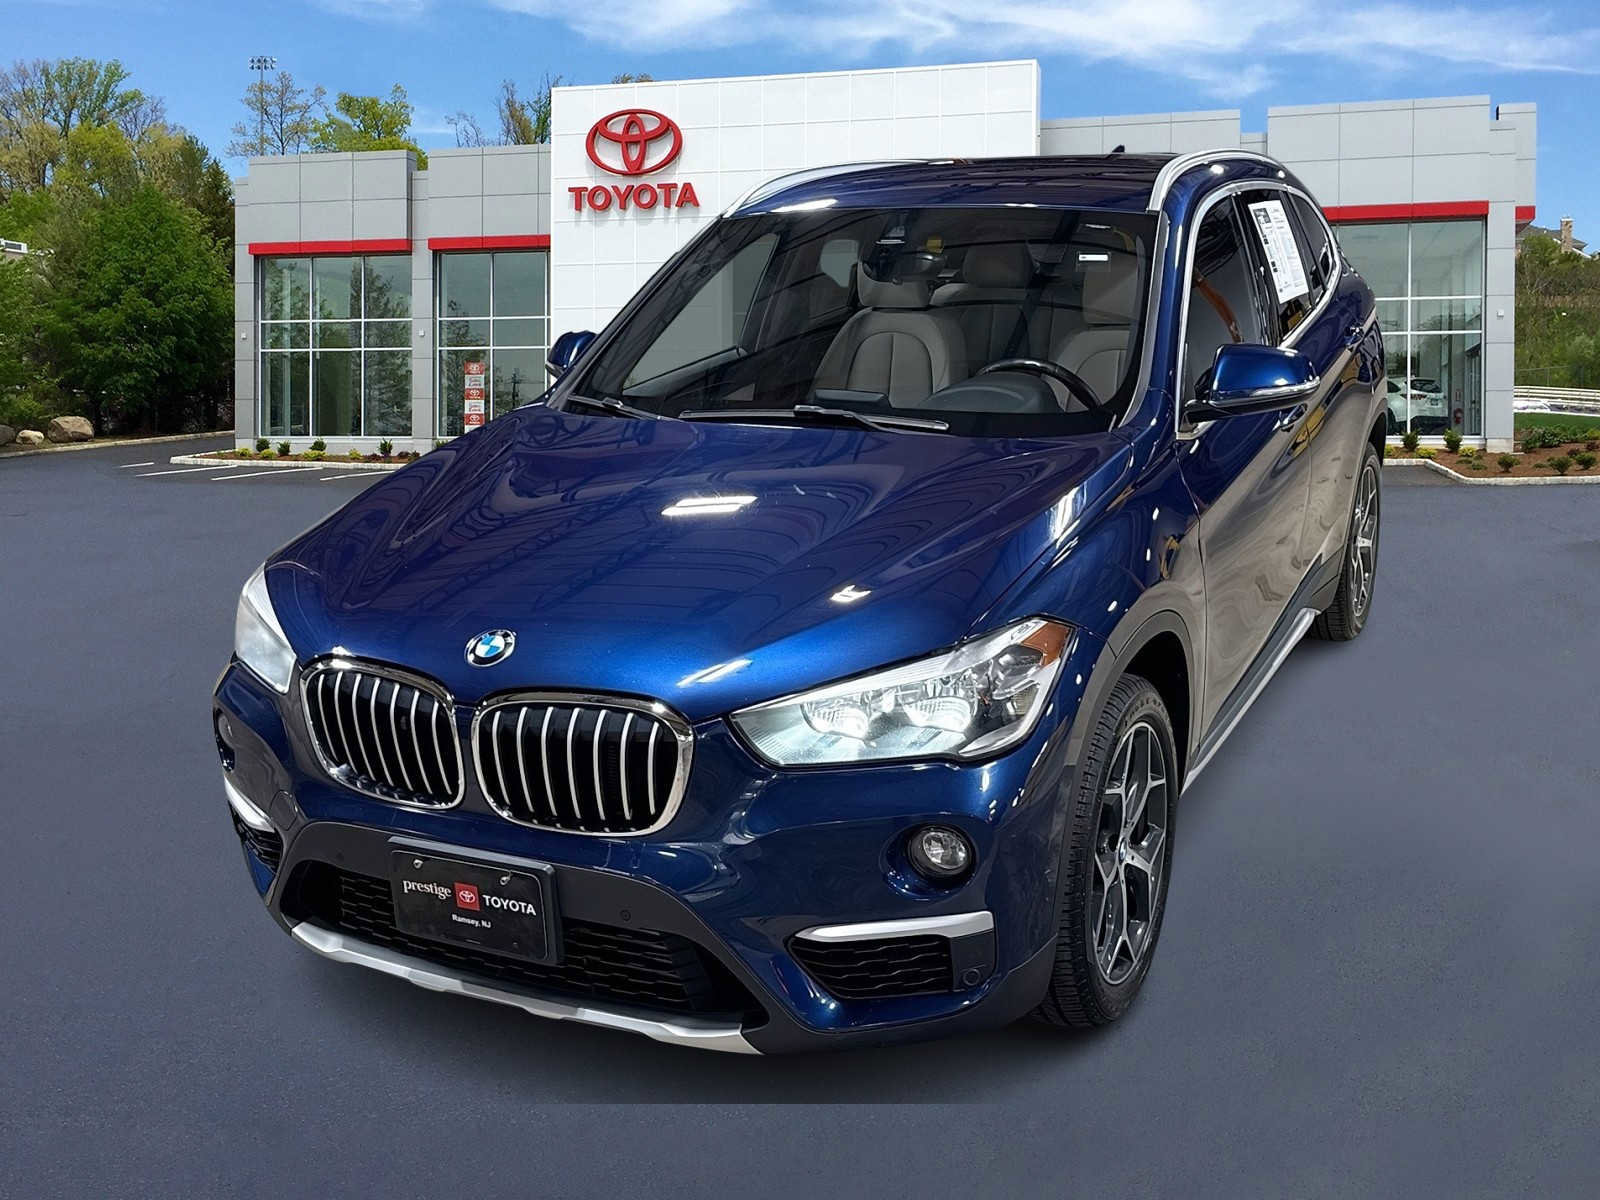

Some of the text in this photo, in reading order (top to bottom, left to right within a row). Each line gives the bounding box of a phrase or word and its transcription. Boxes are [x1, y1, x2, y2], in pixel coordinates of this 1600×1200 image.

[568, 182, 700, 212] TOYOTA
[402, 879, 537, 916] prestige TOYOTA
[452, 914, 492, 929] Ramsey, NJ
